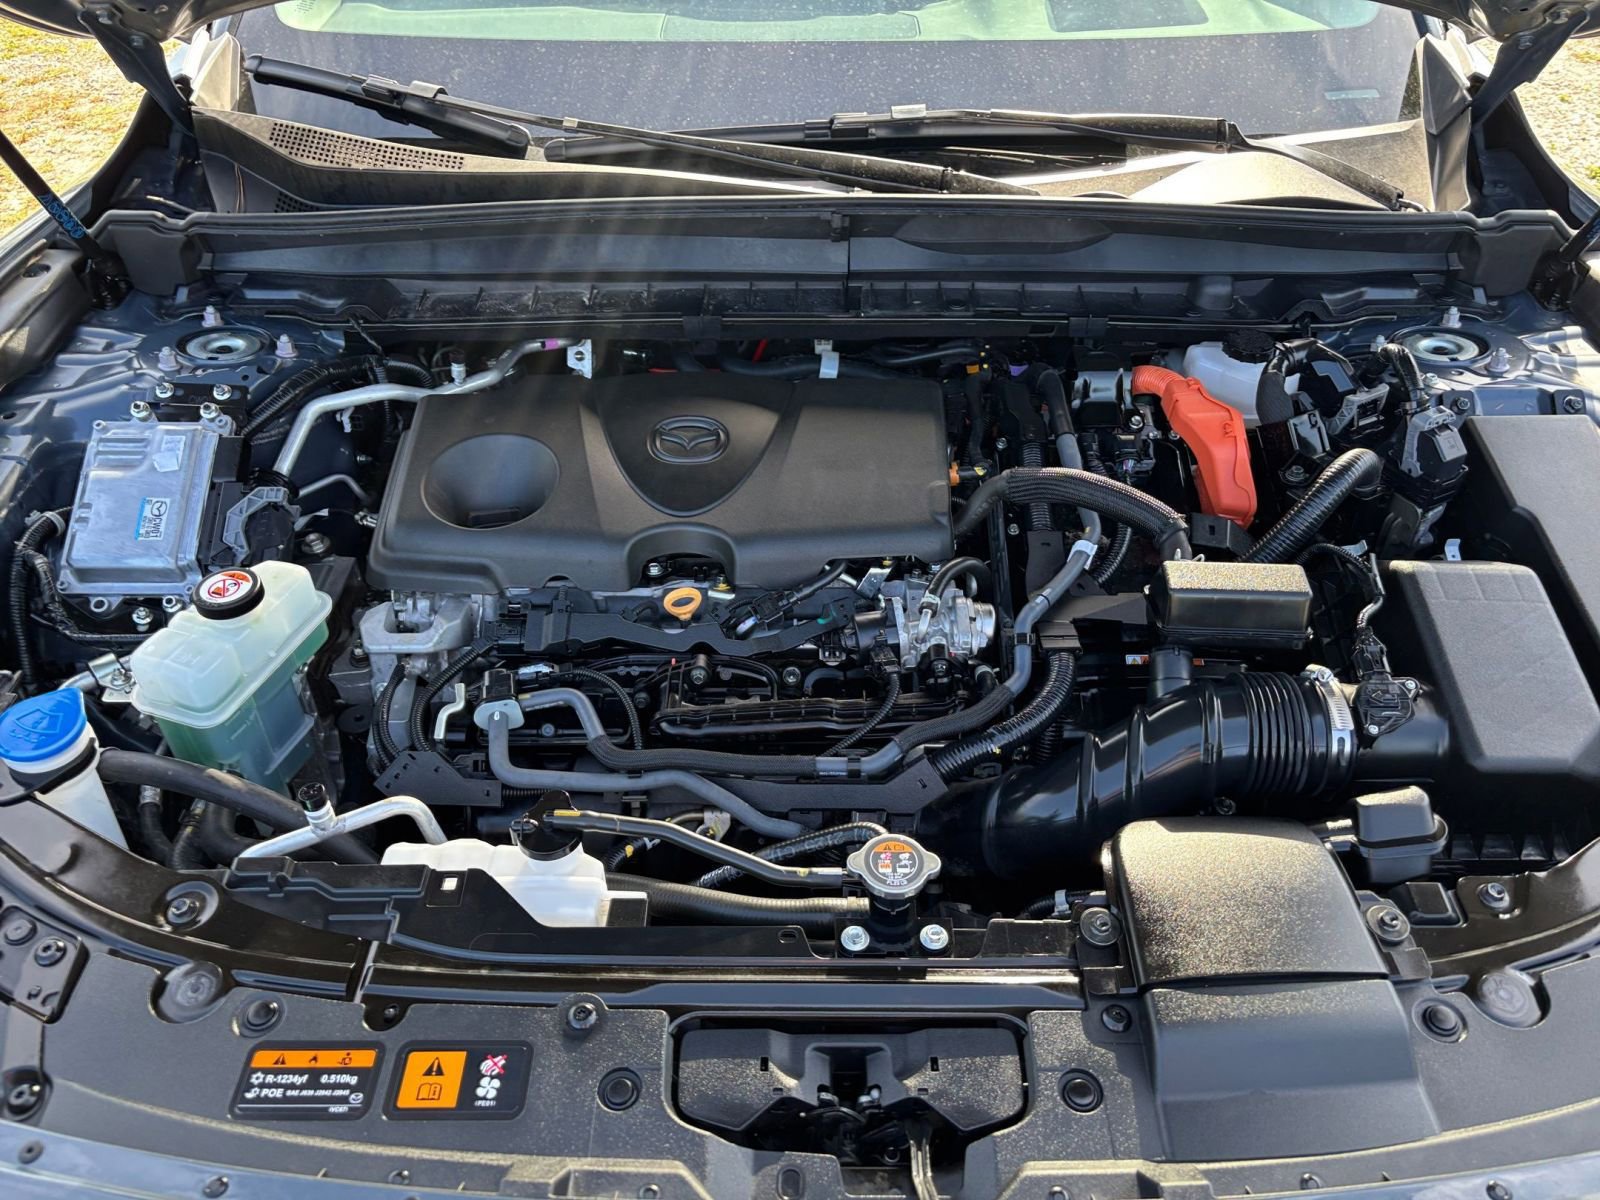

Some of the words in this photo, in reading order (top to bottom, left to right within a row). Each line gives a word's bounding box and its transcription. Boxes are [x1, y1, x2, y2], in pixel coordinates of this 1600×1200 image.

[265, 1074, 309, 1085] R-1234yf
[320, 1074, 358, 1085] 0.510kg
[260, 1088, 284, 1098] POE
